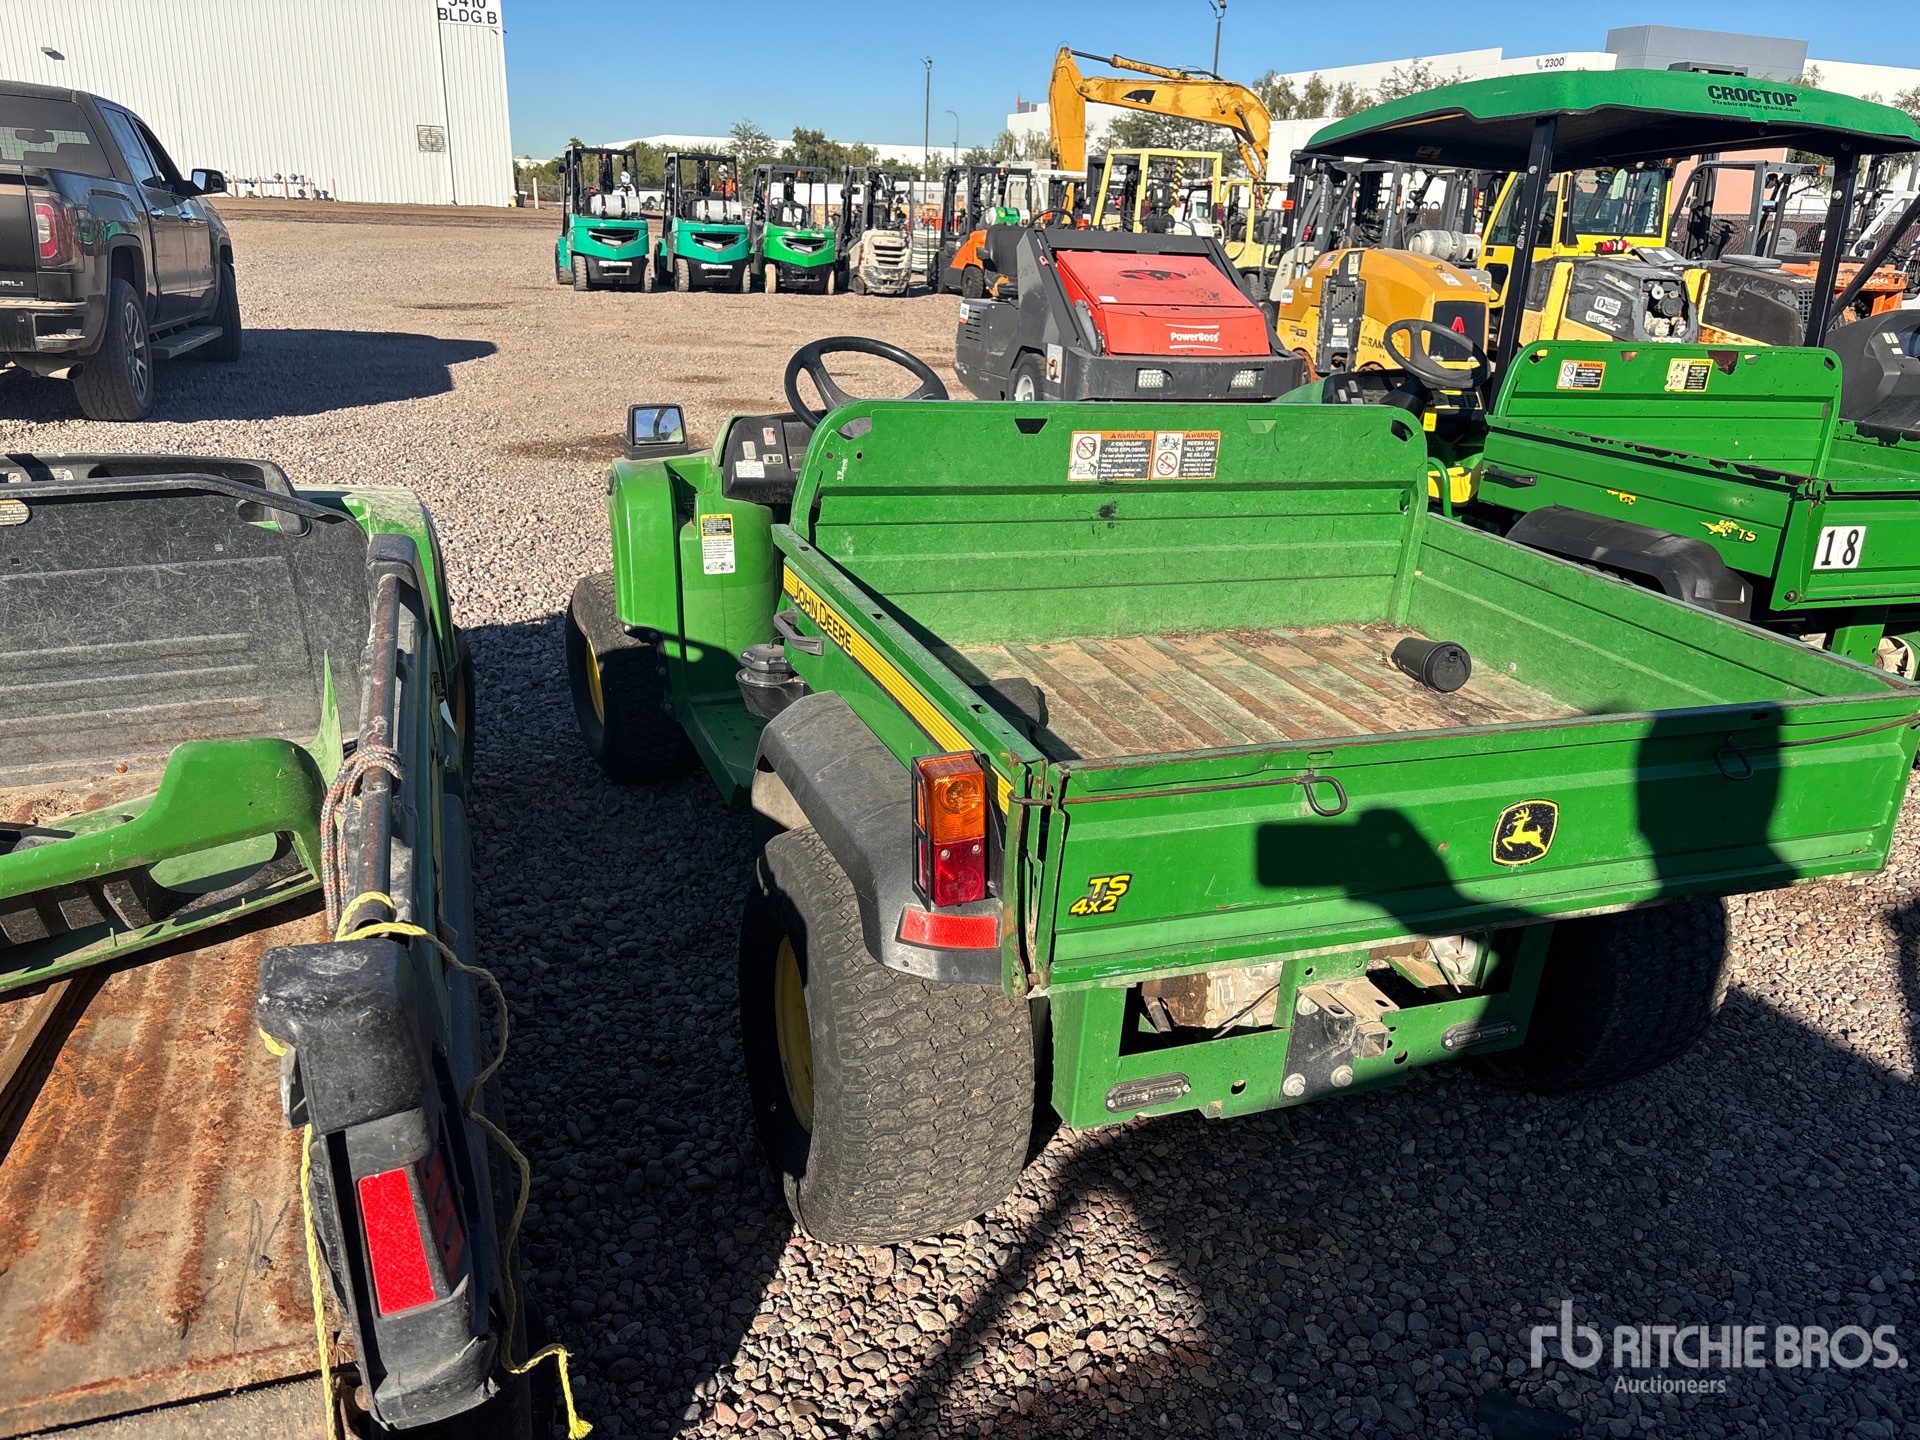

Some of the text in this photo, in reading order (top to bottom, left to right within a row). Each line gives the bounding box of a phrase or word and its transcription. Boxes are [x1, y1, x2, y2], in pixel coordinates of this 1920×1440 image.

[1544, 57, 1565, 68] 2300
[1707, 85, 1798, 107] CROCTOP
[1711, 100, 1801, 113] FirebirdFiberglass.com
[1319, 174, 1329, 213] NISSAN
[1170, 331, 1219, 343] PowerBoss
[1820, 529, 1860, 567] 18
[793, 580, 852, 653] JOHN DEERE
[1089, 875, 1131, 898] TS
[1070, 895, 1118, 915] 4x2
